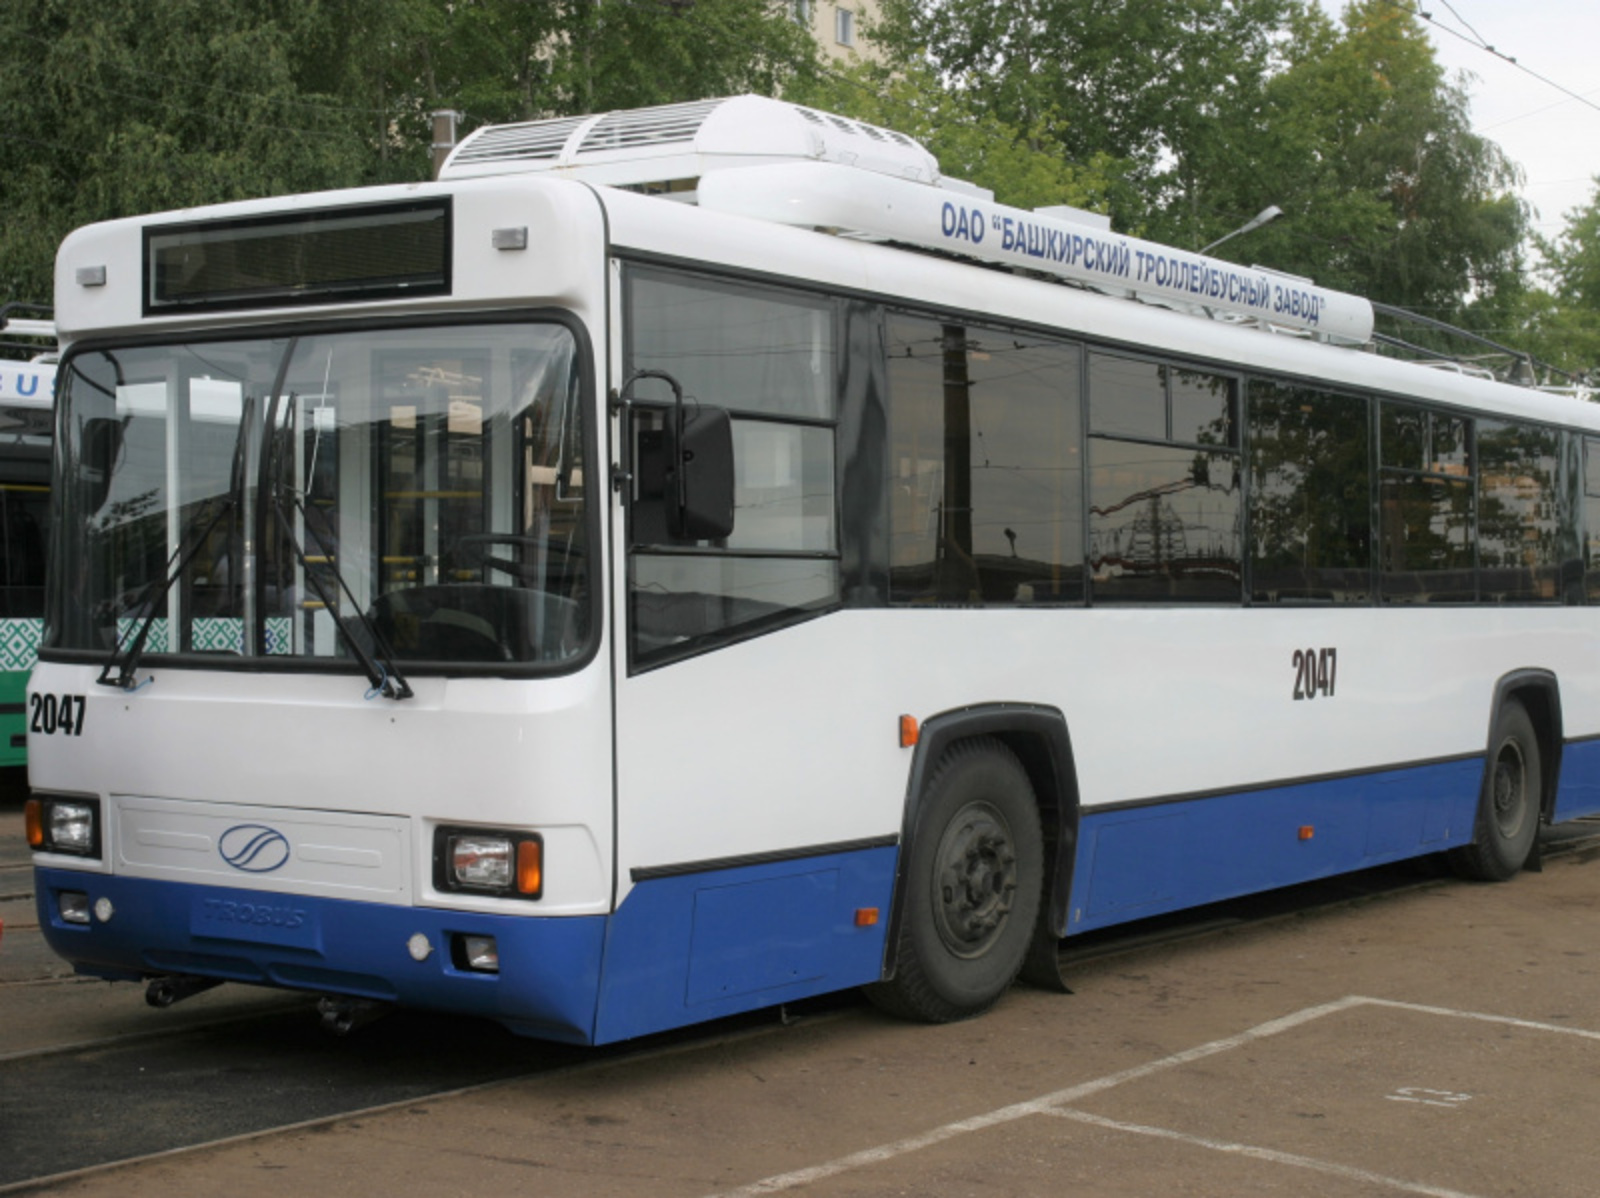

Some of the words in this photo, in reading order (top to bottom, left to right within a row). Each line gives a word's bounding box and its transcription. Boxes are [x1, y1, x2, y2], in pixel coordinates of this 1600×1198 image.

[941, 201, 985, 244] ОАО
[1135, 251, 1270, 309] ТРОЛЛЕЙБУСНЫЙ
[1292, 647, 1336, 700] 2047
[30, 692, 86, 736] 2047
[204, 898, 307, 928] TROBUS
